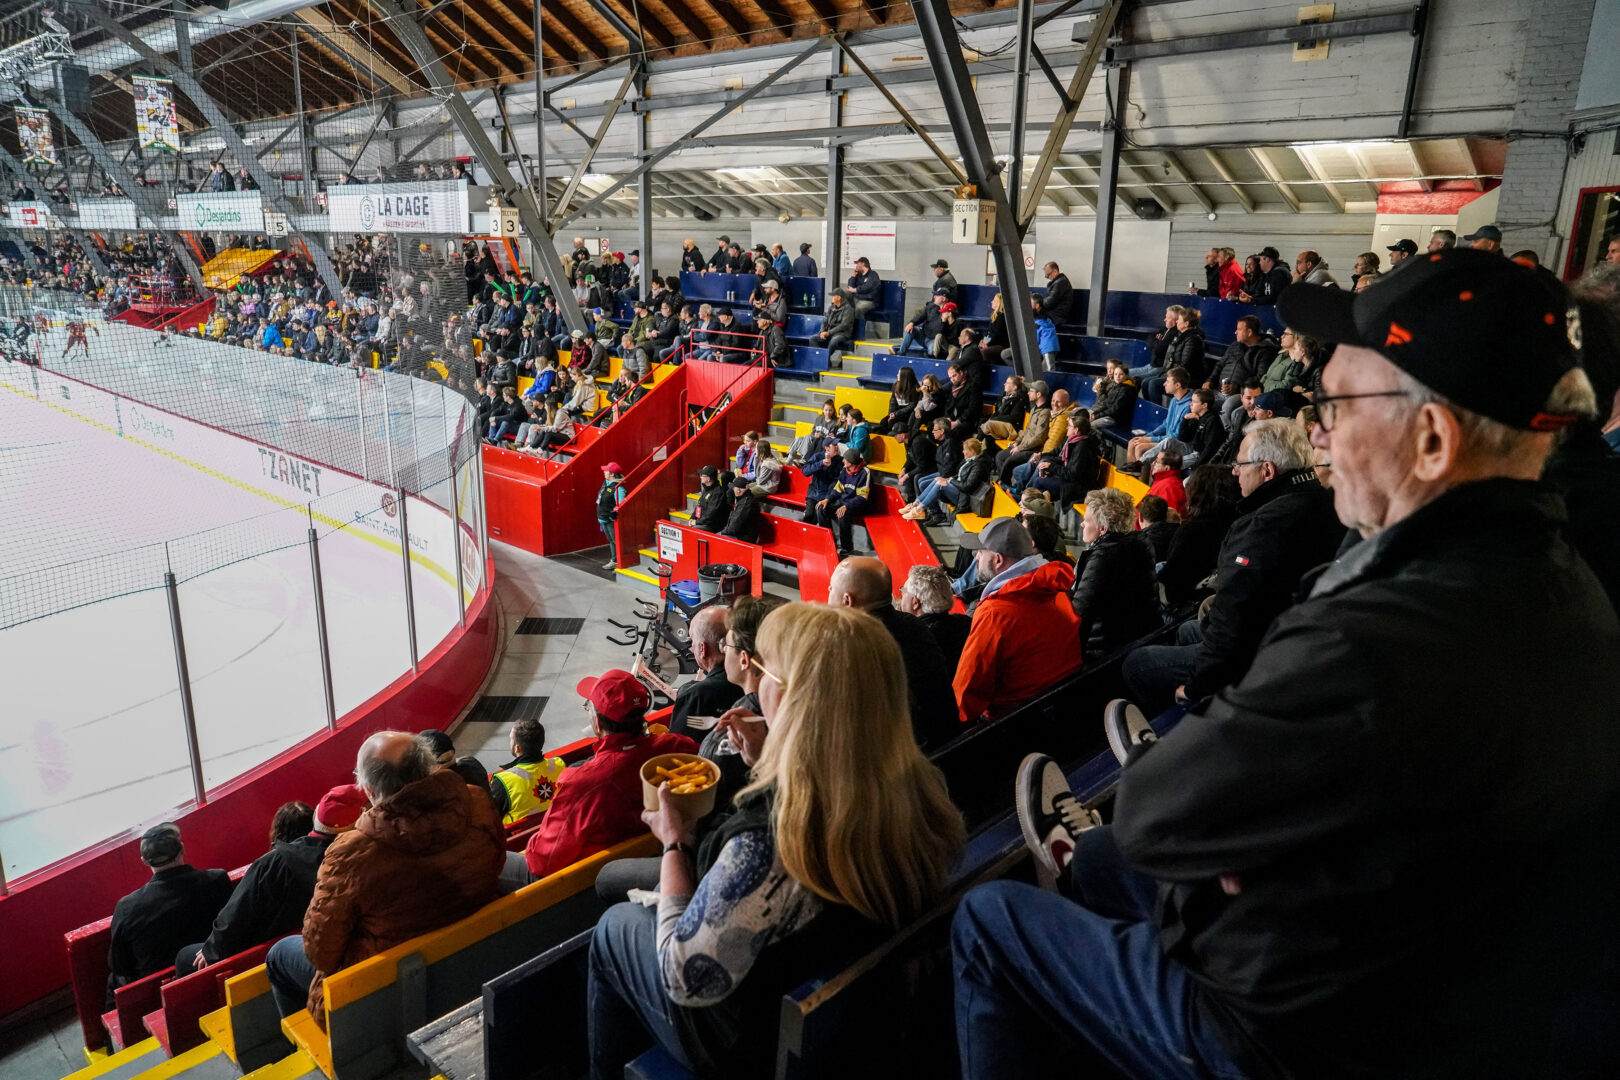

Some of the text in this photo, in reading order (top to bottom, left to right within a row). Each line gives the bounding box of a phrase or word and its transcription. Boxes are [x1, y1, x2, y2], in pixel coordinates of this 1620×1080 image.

[378, 197, 392, 216] LA
[396, 196, 430, 216] CAGE
[954, 204, 977, 212] SECTION
[206, 208, 241, 224] Desjardins
[275, 221, 285, 232] 5
[492, 219, 499, 232] 3
[506, 219, 515, 232] 3
[961, 217, 967, 237] 1
[661, 526, 676, 537] SECTION
